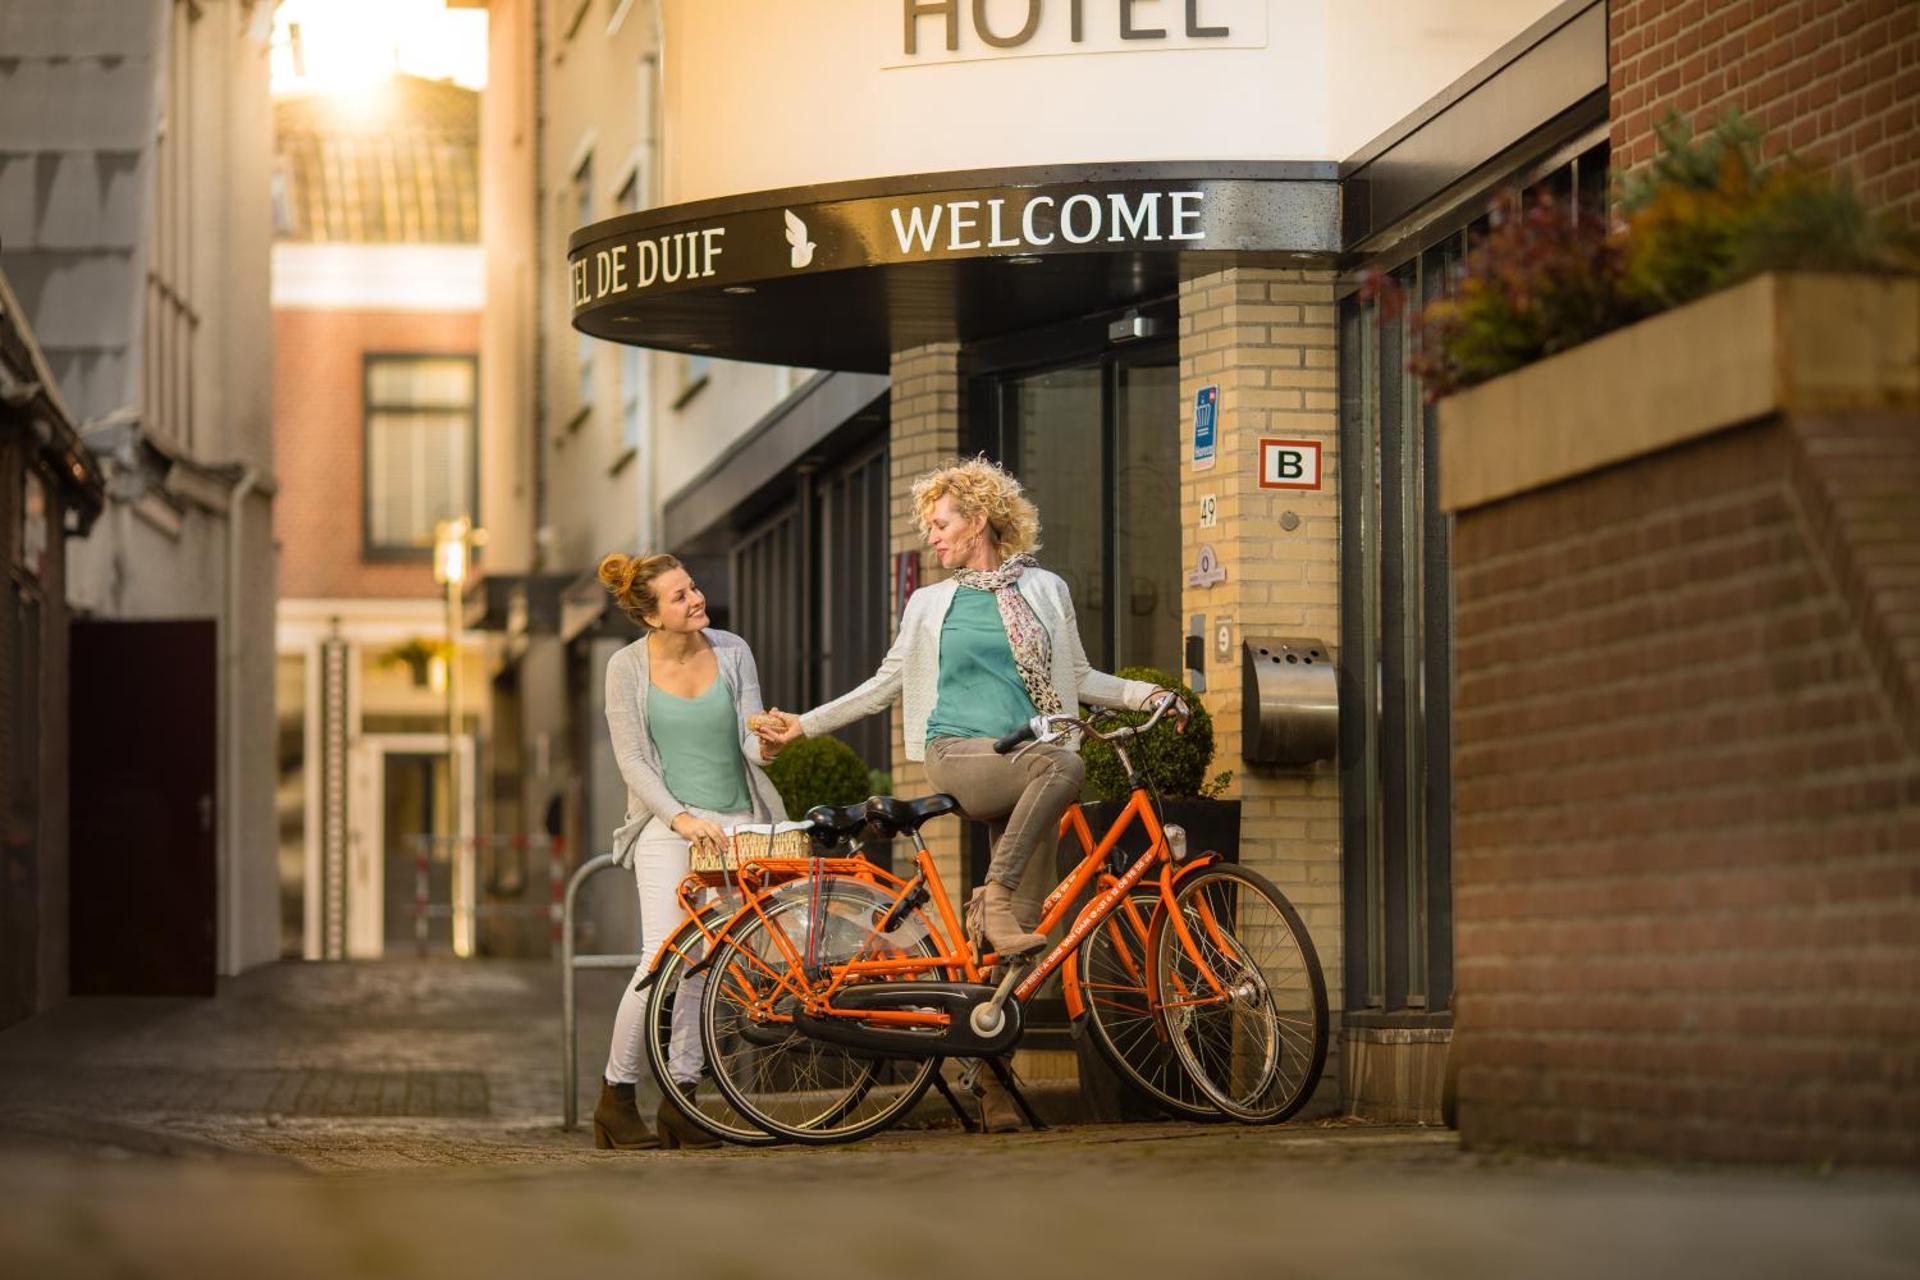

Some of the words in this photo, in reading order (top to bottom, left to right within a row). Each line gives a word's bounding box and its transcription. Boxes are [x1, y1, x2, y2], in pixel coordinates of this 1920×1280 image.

[890, 191, 1206, 254] WELCOME
[597, 245, 628, 298] DE
[637, 227, 725, 288] DUIF
[1278, 450, 1303, 479] B
[1201, 498, 1215, 525] 49
